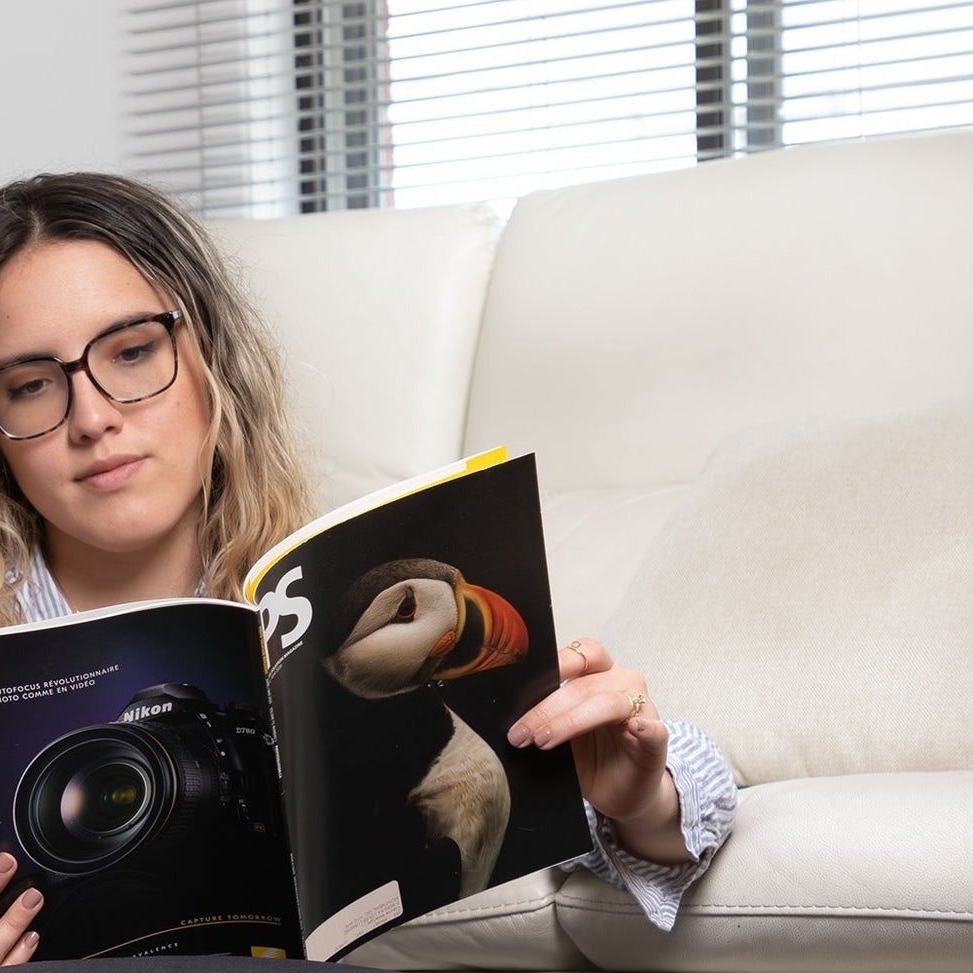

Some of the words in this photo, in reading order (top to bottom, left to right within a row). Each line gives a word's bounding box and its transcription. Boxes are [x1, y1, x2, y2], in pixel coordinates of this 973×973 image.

[22, 689, 54, 700] COMME
[57, 686, 67, 694] EN
[123, 701, 173, 724] Nikon
[180, 914, 223, 926] CAPTURE
[227, 914, 281, 922] TOMORROW
